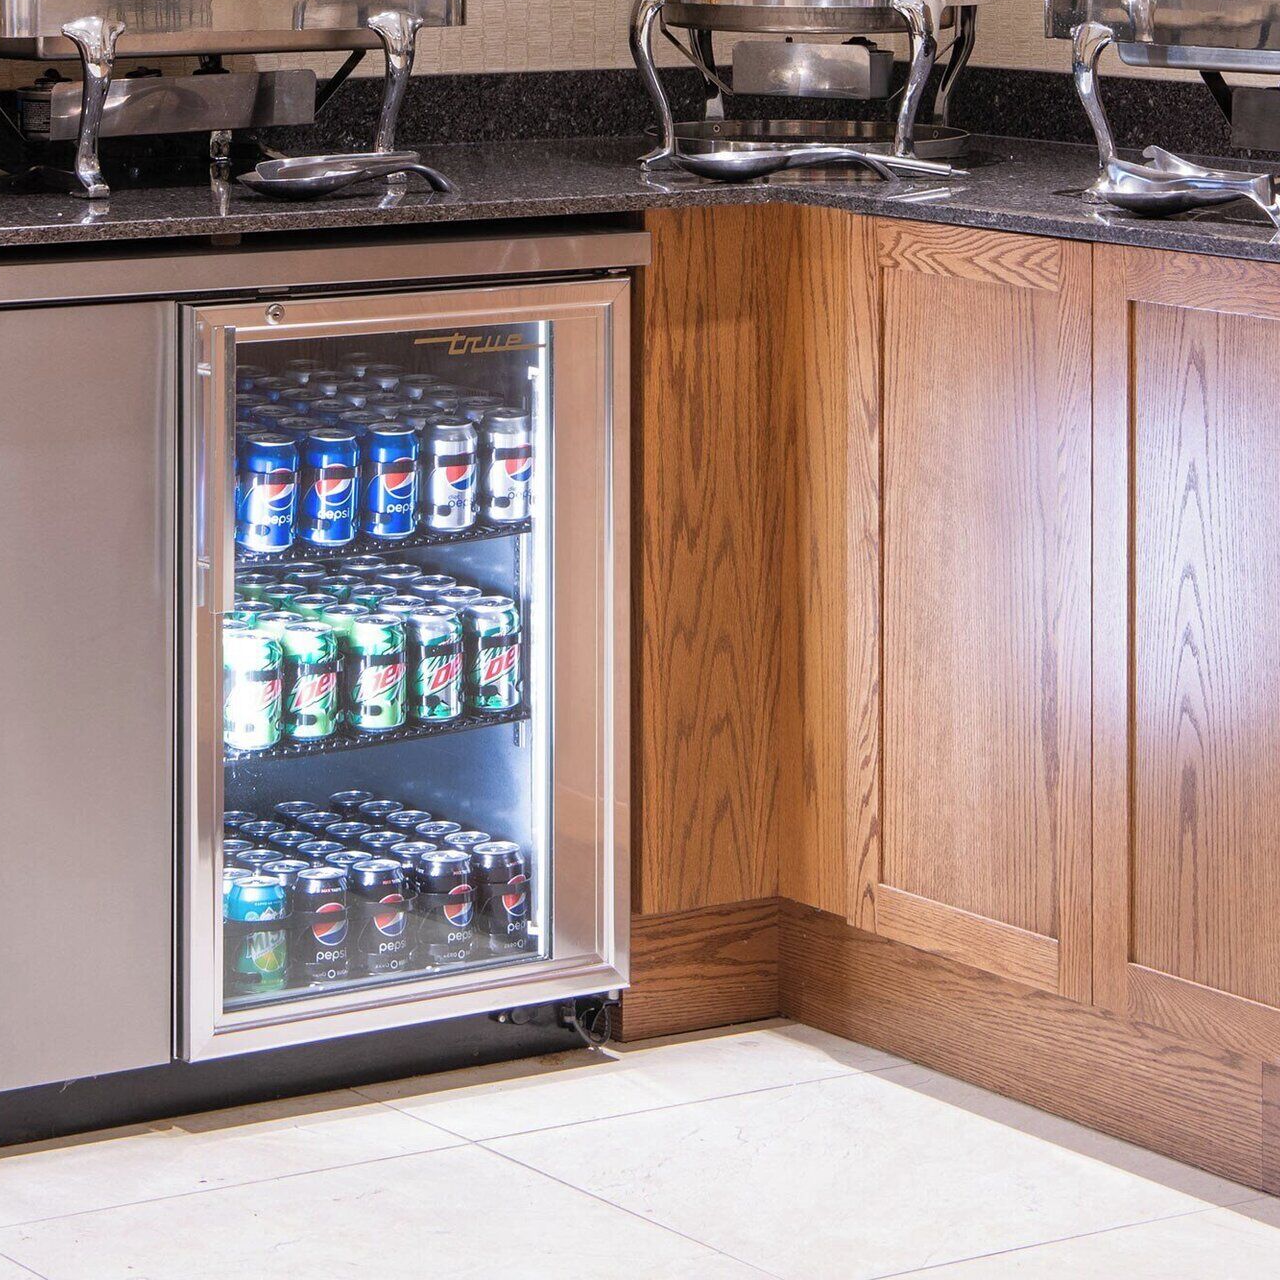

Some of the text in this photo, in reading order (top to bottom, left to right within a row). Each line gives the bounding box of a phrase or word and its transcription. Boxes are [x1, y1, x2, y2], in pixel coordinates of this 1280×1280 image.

[414, 332, 524, 356] true
[387, 500, 414, 513] peps
[263, 513, 291, 527] peps
[318, 507, 351, 522] pepsi
[448, 929, 472, 944] peps
[379, 939, 407, 954] peps
[316, 947, 347, 963] pepsi
